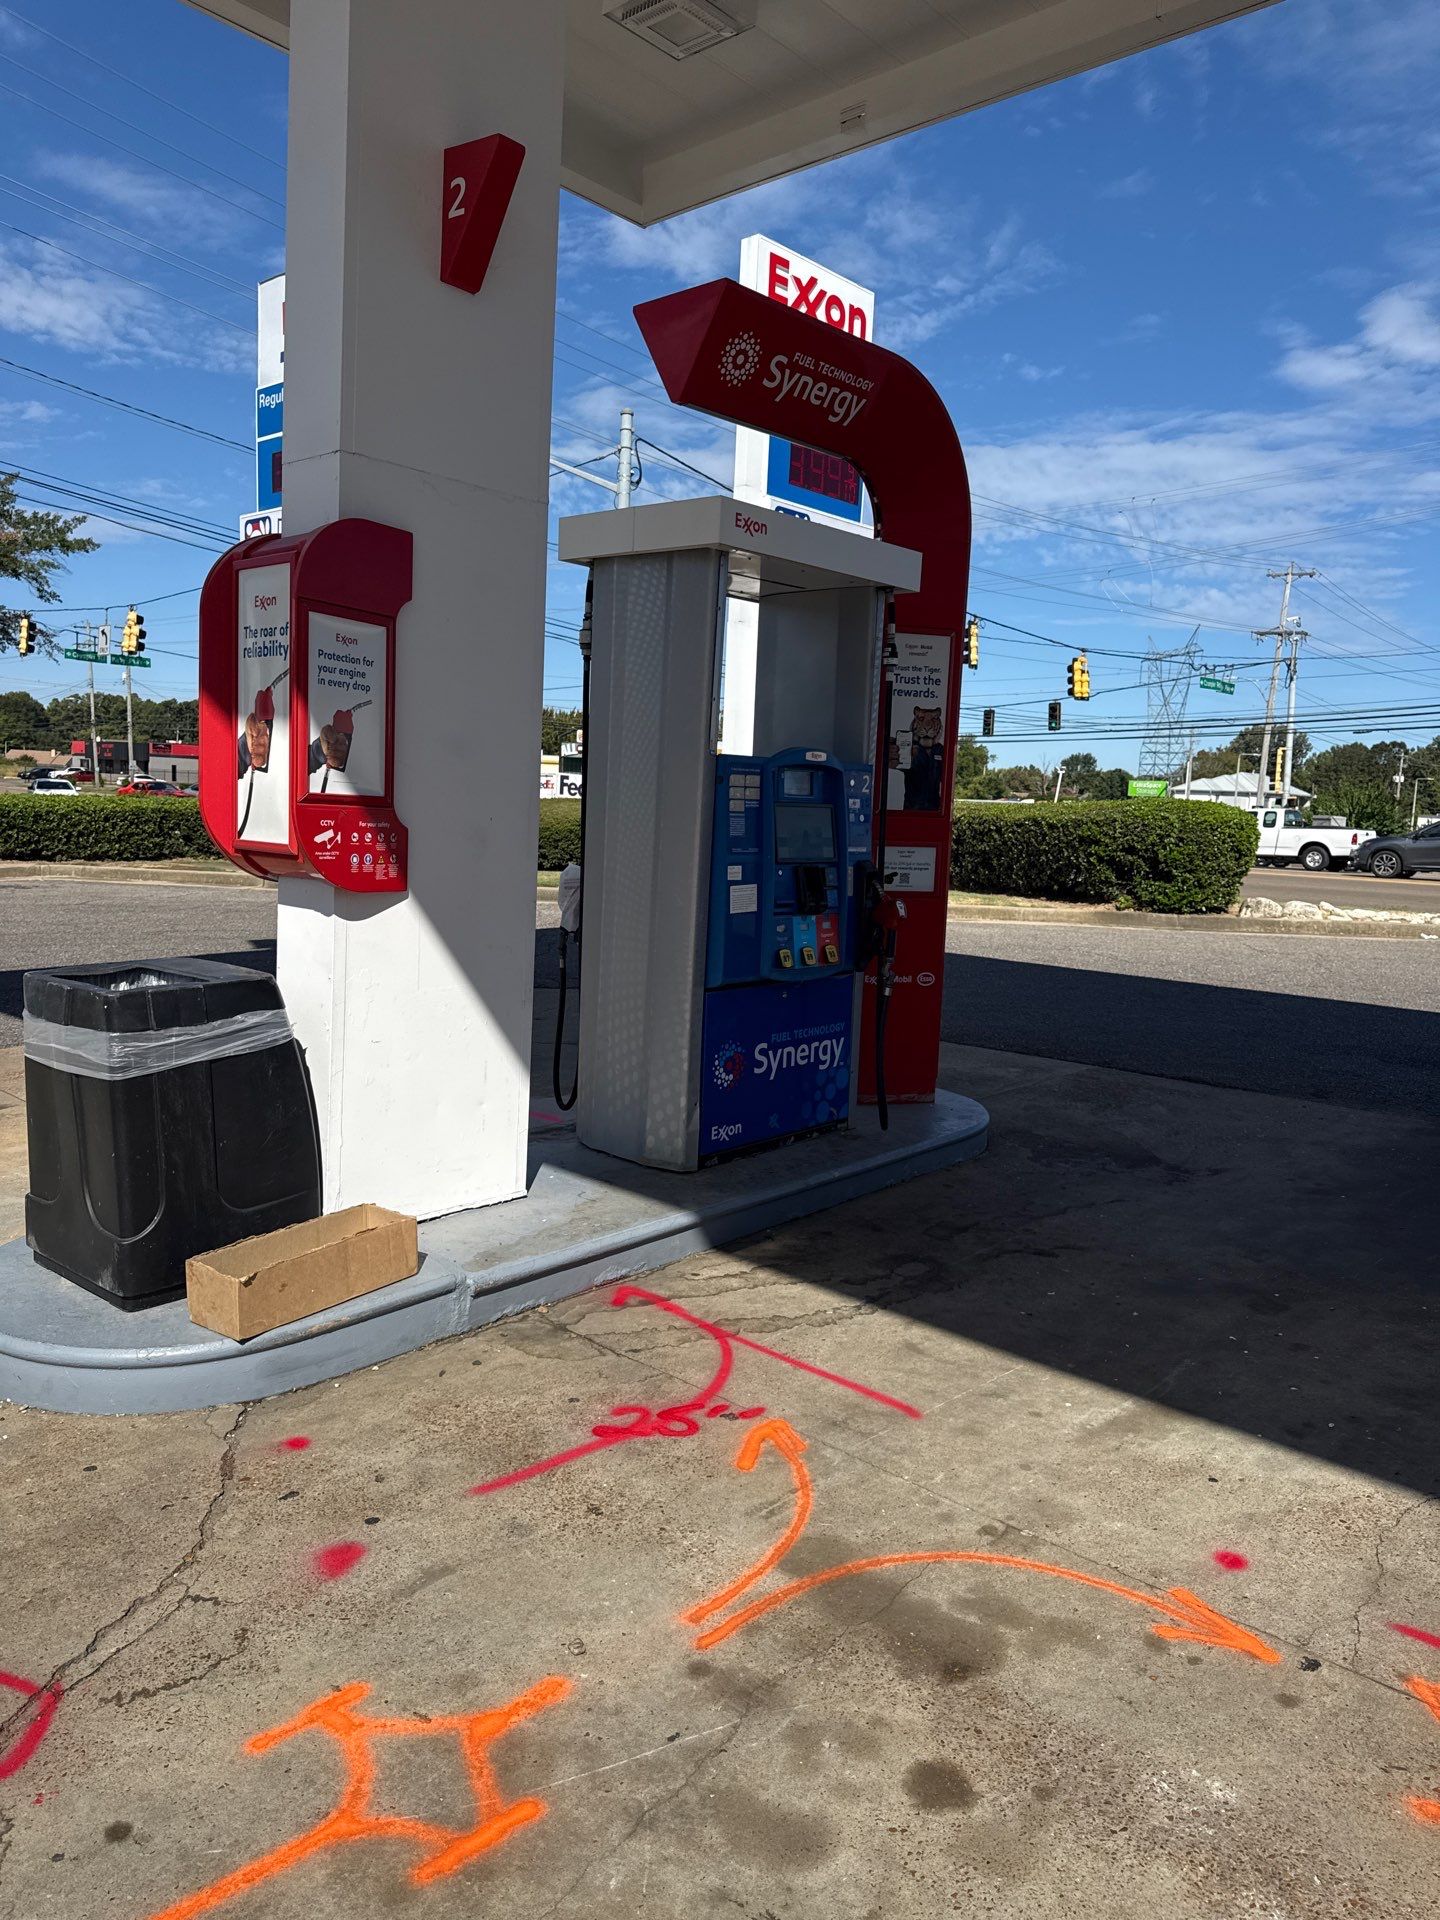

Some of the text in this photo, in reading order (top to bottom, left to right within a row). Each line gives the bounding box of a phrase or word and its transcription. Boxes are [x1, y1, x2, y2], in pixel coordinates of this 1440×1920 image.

[448, 176, 466, 219] 2
[768, 252, 867, 340] Exxon
[792, 352, 875, 392] FUEL TECHNOLOGY
[258, 387, 284, 409] Regul
[762, 354, 868, 427] Synergy
[734, 512, 767, 537] Exxon
[254, 595, 277, 611] Exxon
[243, 621, 289, 639] The roar of
[335, 632, 358, 647] Exxon
[243, 640, 289, 661] reliability
[317, 648, 375, 668] Protection for
[317, 664, 367, 680] your engine
[893, 673, 941, 686] Trust the
[911, 664, 923, 673] the
[924, 665, 942, 675] Tiger.
[317, 677, 371, 694] in every drop
[892, 687, 938, 699] rewards.
[861, 774, 870, 793] 2
[320, 819, 335, 827] CCTV
[771, 1021, 846, 1043] FUEL TECHNOLOGY
[753, 1036, 845, 1081] Synergy
[710, 1122, 743, 1142] Exxon
